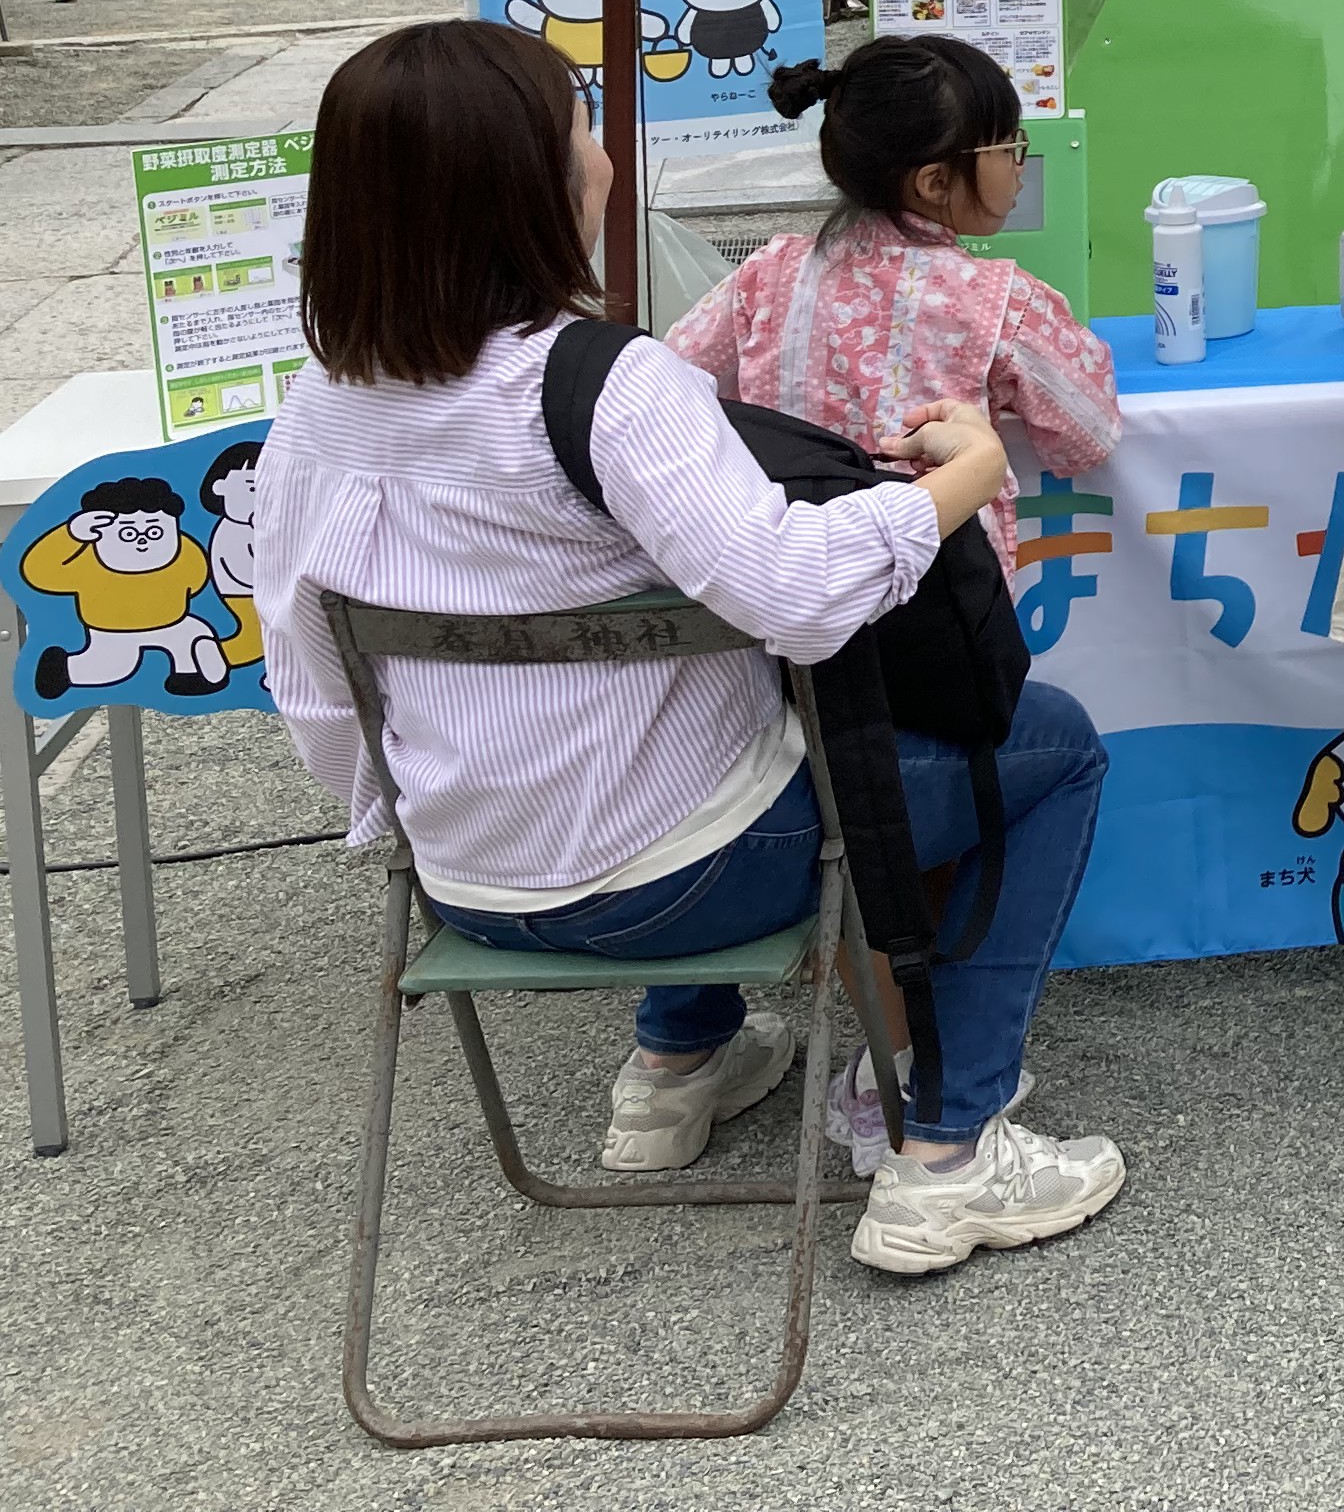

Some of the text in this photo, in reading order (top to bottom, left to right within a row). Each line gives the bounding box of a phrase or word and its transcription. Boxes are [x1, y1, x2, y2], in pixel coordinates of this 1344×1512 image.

[710, 89, 757, 103] やらねーこ
[142, 138, 278, 171] 野菜摂取度測定器
[210, 157, 287, 182] 測定方法
[1259, 866, 1317, 888] まち犬
